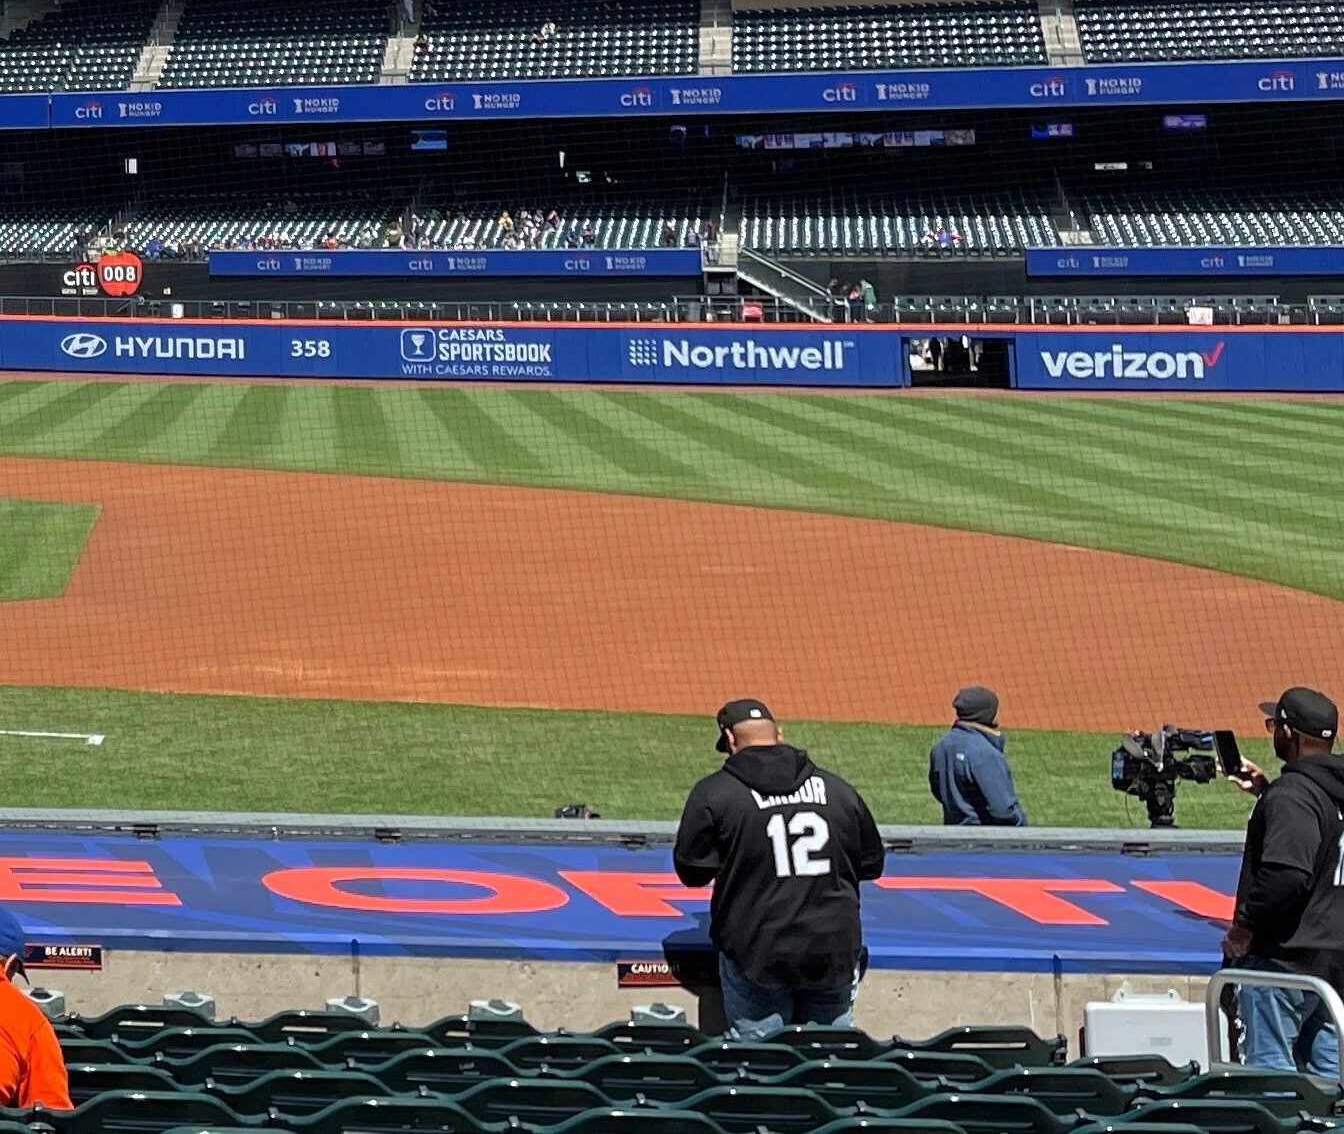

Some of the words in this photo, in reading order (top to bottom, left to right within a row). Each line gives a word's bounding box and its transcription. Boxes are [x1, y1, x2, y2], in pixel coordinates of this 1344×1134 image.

[889, 84, 906, 93] NO
[908, 84, 929, 92] KID
[1029, 78, 1065, 97] citi
[1100, 78, 1118, 88] NO
[1120, 78, 1141, 87] KID
[1258, 72, 1294, 91] citi
[484, 95, 500, 103] NO
[502, 94, 520, 102] KID
[620, 89, 652, 107] citi
[683, 89, 700, 98] NO
[701, 89, 721, 97] KID
[823, 83, 856, 102] citi
[129, 103, 143, 111] NO
[145, 103, 161, 111] KID
[248, 99, 277, 115] citi
[305, 99, 320, 107] NO
[321, 98, 339, 106] KID
[424, 95, 454, 111] citi
[75, 104, 102, 119] citi
[63, 265, 95, 286] citi
[104, 266, 136, 282] 008
[115, 336, 244, 359] HYUNDAI
[291, 340, 330, 358] 358
[439, 343, 552, 362] SPORTSBOOK
[663, 339, 844, 369] Northwell
[1040, 343, 1204, 379] verizon
[401, 364, 432, 374] WITH
[436, 365, 489, 376] CAESARS
[766, 811, 831, 878] 12
[44, 946, 58, 956] BE
[59, 947, 92, 957] ALERT!
